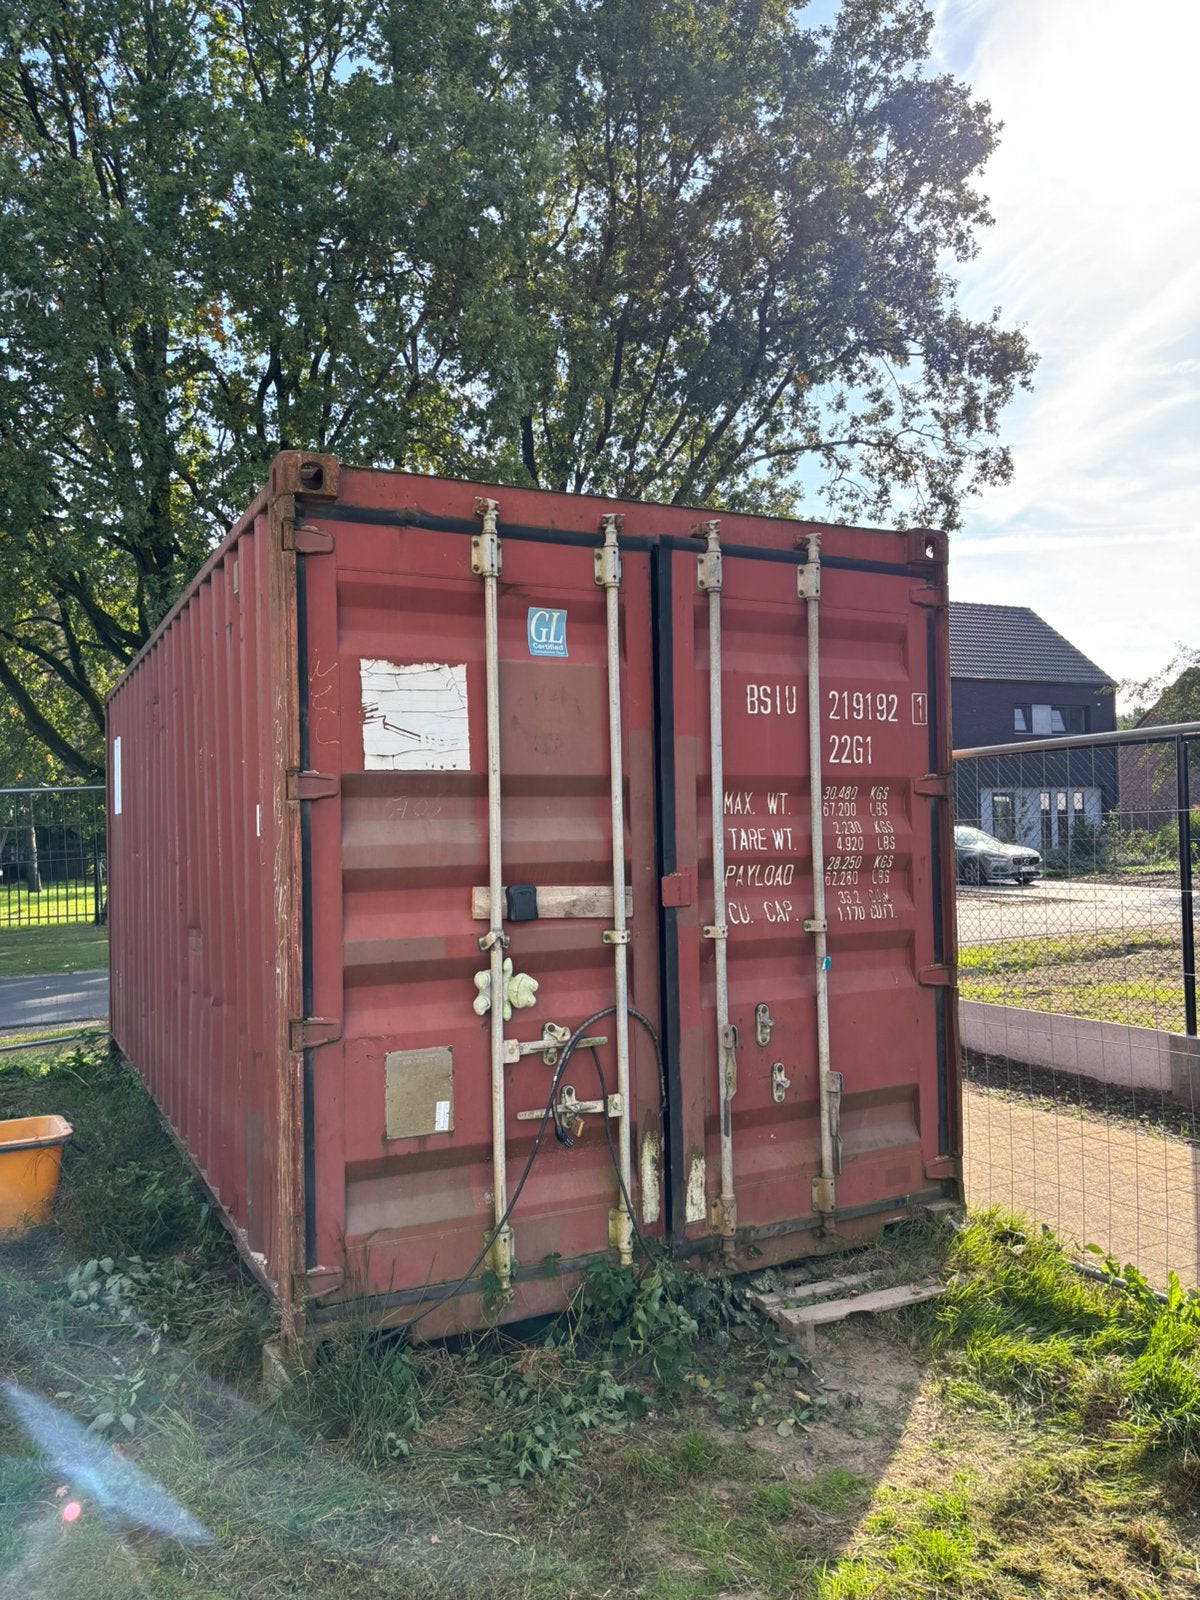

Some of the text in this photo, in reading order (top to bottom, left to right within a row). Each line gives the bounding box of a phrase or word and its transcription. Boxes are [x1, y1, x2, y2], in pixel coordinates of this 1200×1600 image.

[530, 610, 564, 643] GL
[746, 684, 797, 715] BSIU
[828, 690, 899, 722] 219192
[828, 735, 872, 764] 22G1
[823, 785, 890, 800] 30.480 KGS
[723, 791, 792, 815] MAX. WT.
[822, 802, 888, 817] 67.200 LBS
[832, 820, 894, 834] 2.230 KGS
[728, 828, 797, 850] TARE WT.
[836, 835, 896, 851] 4.920 LBS
[826, 854, 894, 870] 28.250 KGS
[725, 864, 795, 887] PAYLOAD
[825, 869, 890, 886] 62.280 LBS
[837, 889, 862, 904] 33.2
[728, 900, 799, 924] CU. CAP.
[837, 905, 866, 921] 1.170
